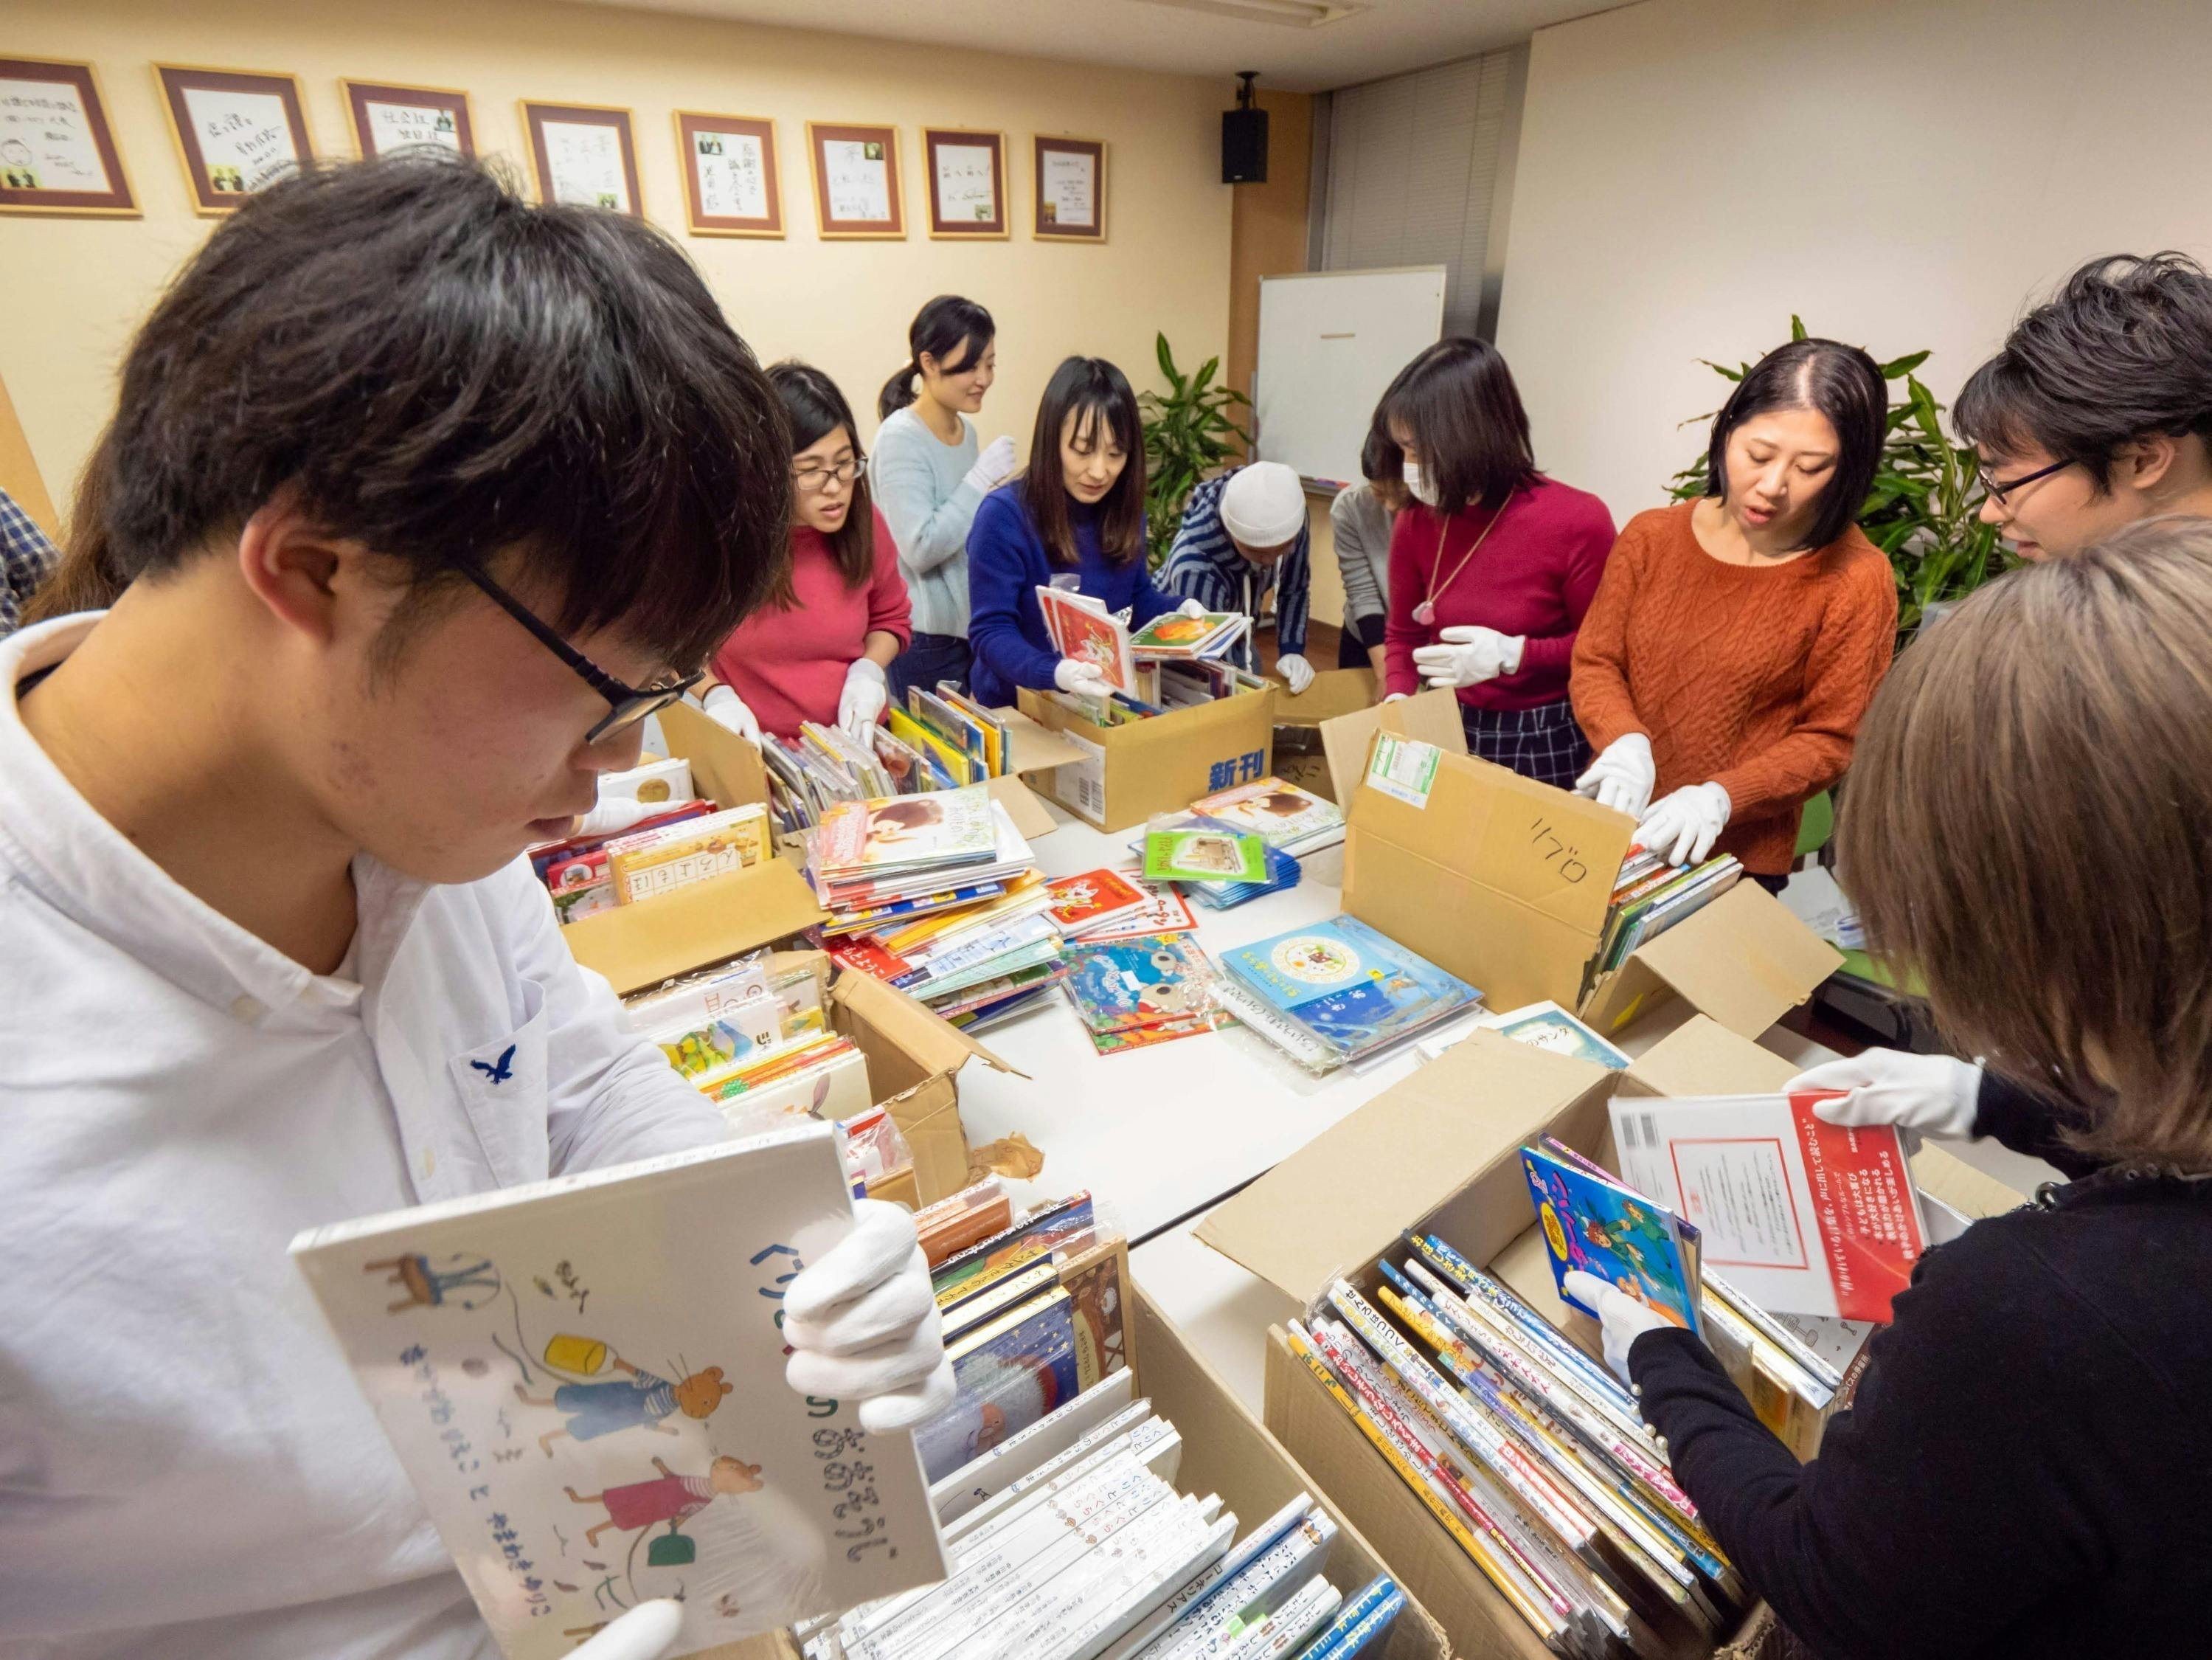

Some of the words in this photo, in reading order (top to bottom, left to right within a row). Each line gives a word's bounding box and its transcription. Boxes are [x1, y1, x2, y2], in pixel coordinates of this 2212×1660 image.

[1208, 748, 1264, 793] 新刊
[1847, 1172, 1871, 1234] 子どもは大喜び
[1860, 1169, 1883, 1239] 本が大好きになる
[1345, 1289, 1404, 1349] せんろはつづく
[1301, 1351, 1337, 1389] おこる
[1449, 1336, 1583, 1455] おしりたんてい
[1332, 1354, 1421, 1452] おいしそうなしろくま
[1367, 1408, 1432, 1480] ほしをさがしに
[814, 1425, 899, 1563] おおそうじ
[1082, 1473, 1143, 1516] ぐりとぐら
[1103, 1490, 1162, 1533] ぐりとぐら
[1166, 1563, 1224, 1614] コーネリアス
[1288, 1603, 1320, 1637] いちばん
